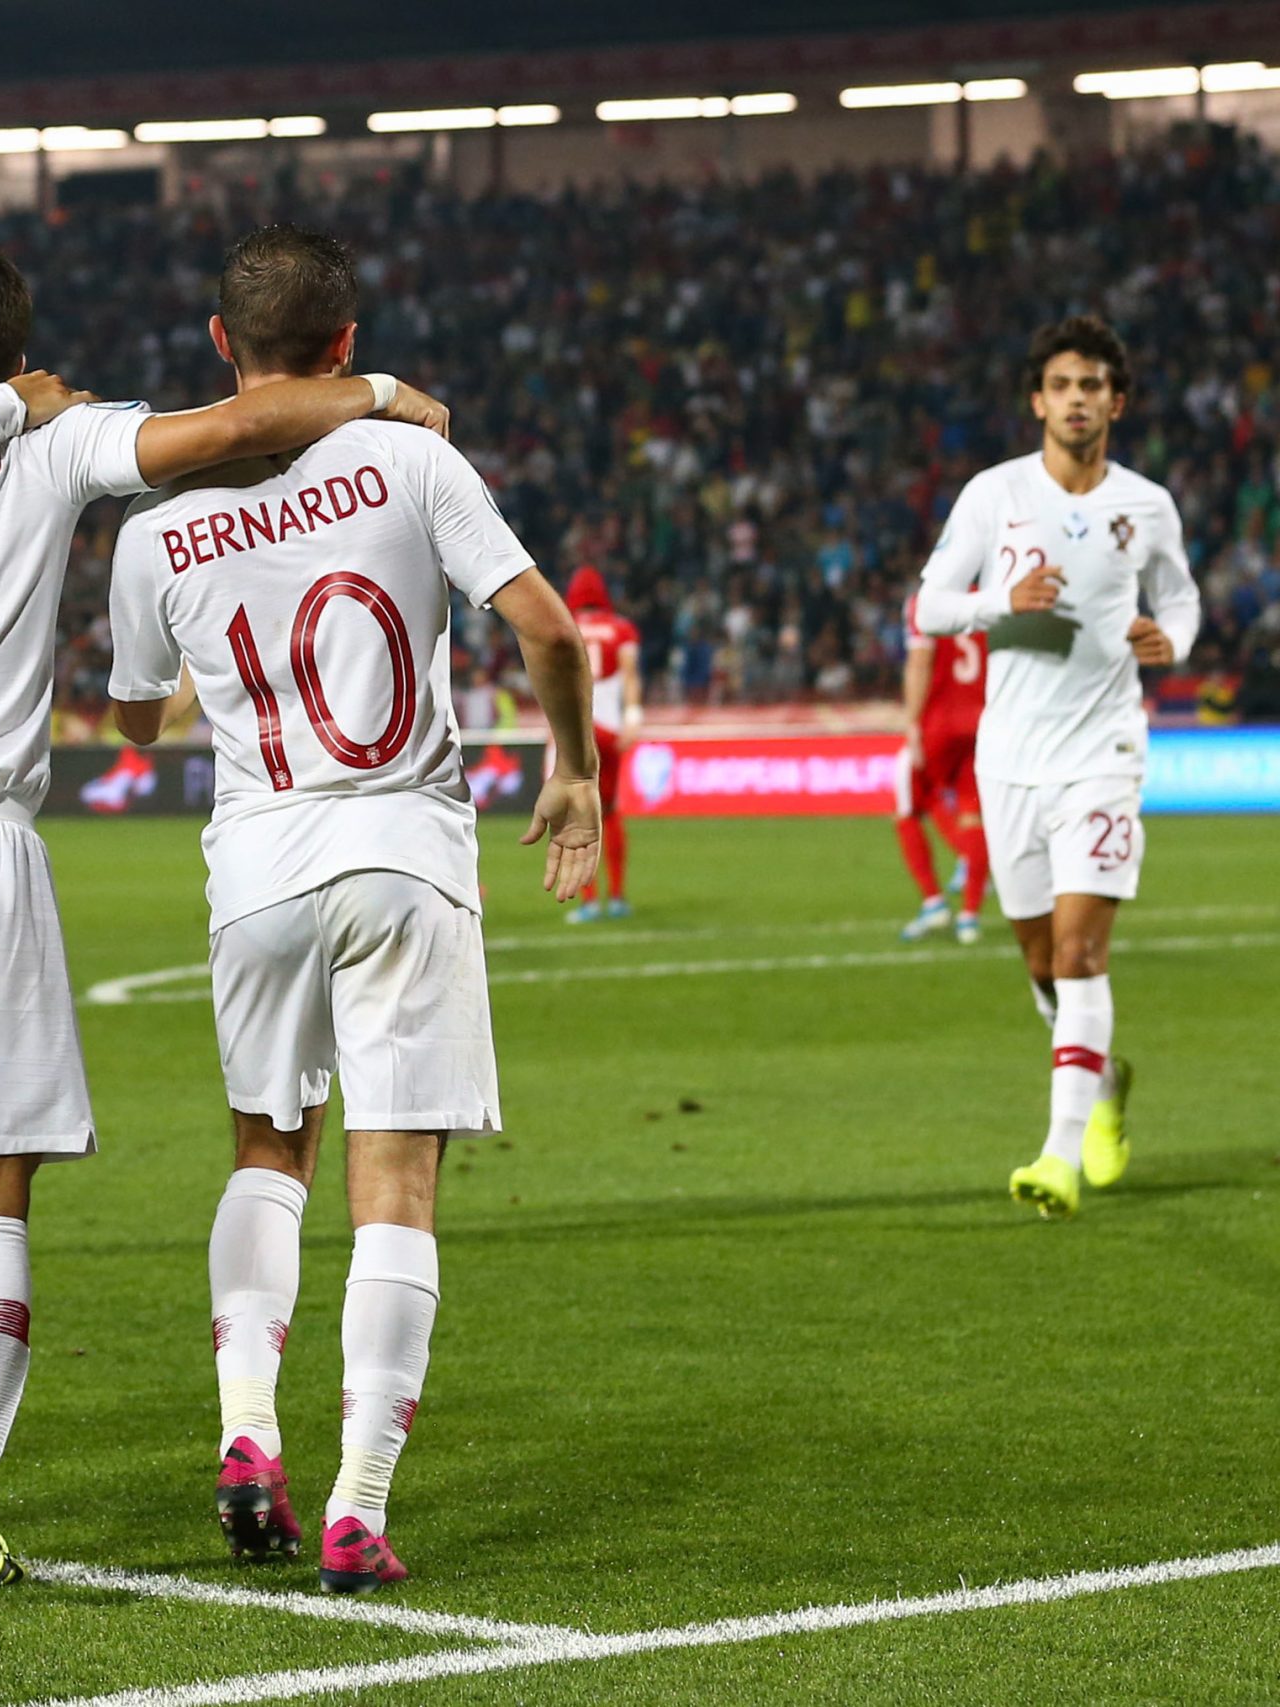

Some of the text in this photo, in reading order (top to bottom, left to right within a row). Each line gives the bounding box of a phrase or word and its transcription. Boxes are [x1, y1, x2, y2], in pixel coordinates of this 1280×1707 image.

[162, 465, 389, 575] BERNARDO
[225, 570, 417, 793] 10
[1087, 810, 1133, 862] 23
